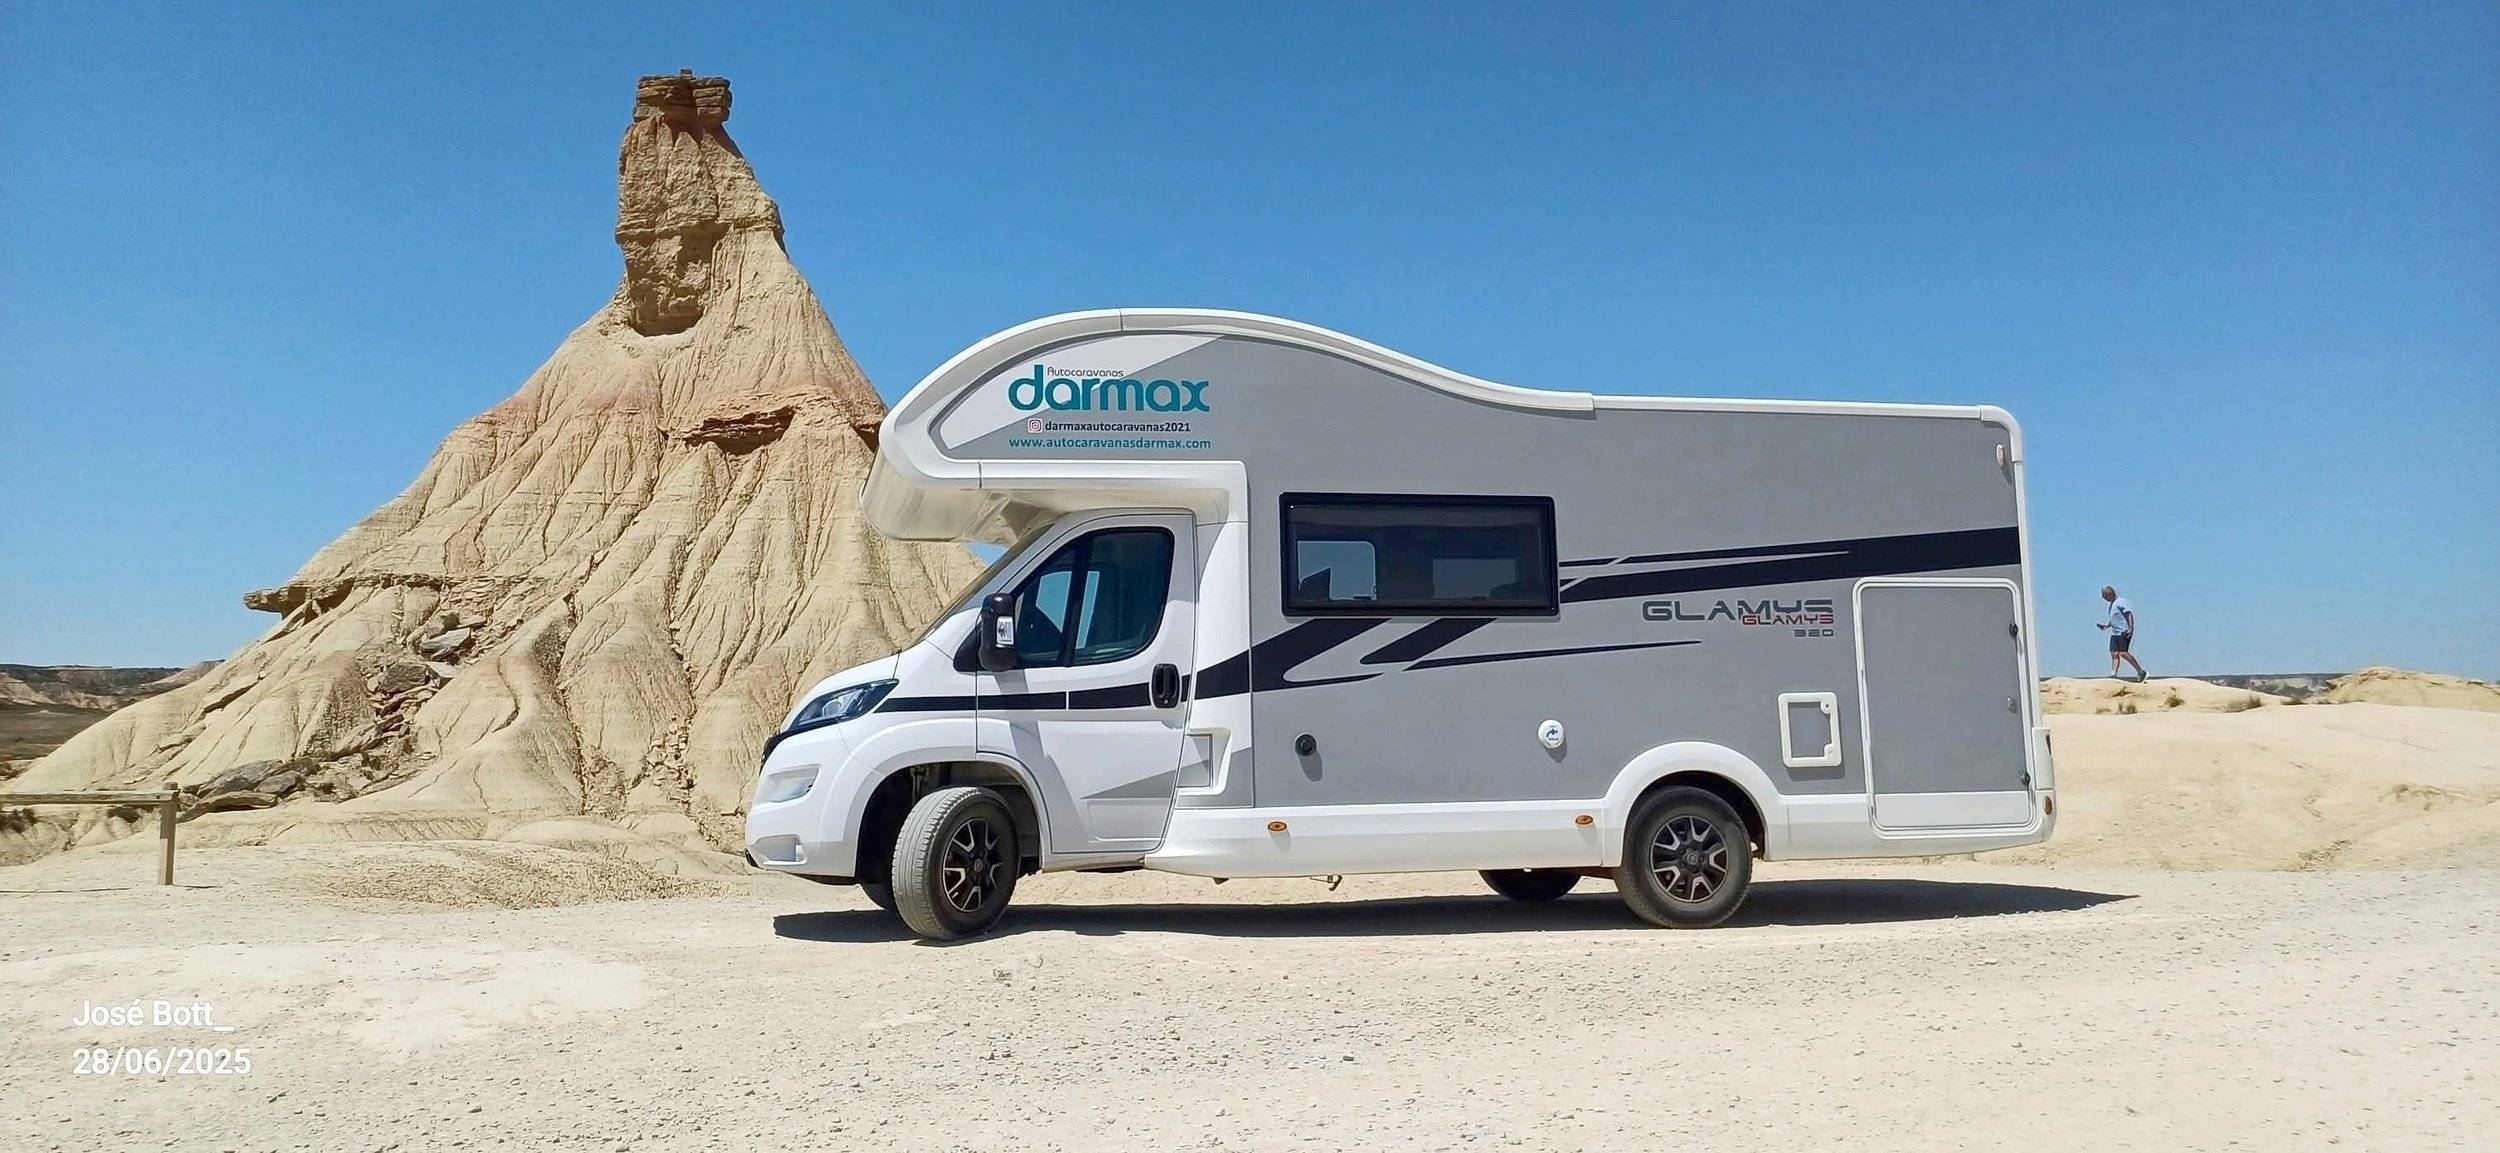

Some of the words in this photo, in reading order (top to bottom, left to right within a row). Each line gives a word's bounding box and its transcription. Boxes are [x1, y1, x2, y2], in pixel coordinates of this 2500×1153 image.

[1047, 366, 1124, 377] Autocaravanas
[1008, 364, 1210, 412] darmax
[1045, 421, 1191, 433] darmaxautocaravanas2021
[1009, 437, 1211, 449] www.autocaravanasdarmax.com
[1642, 600, 1833, 621] GLAMYS
[1742, 614, 1834, 625] GLAMYS
